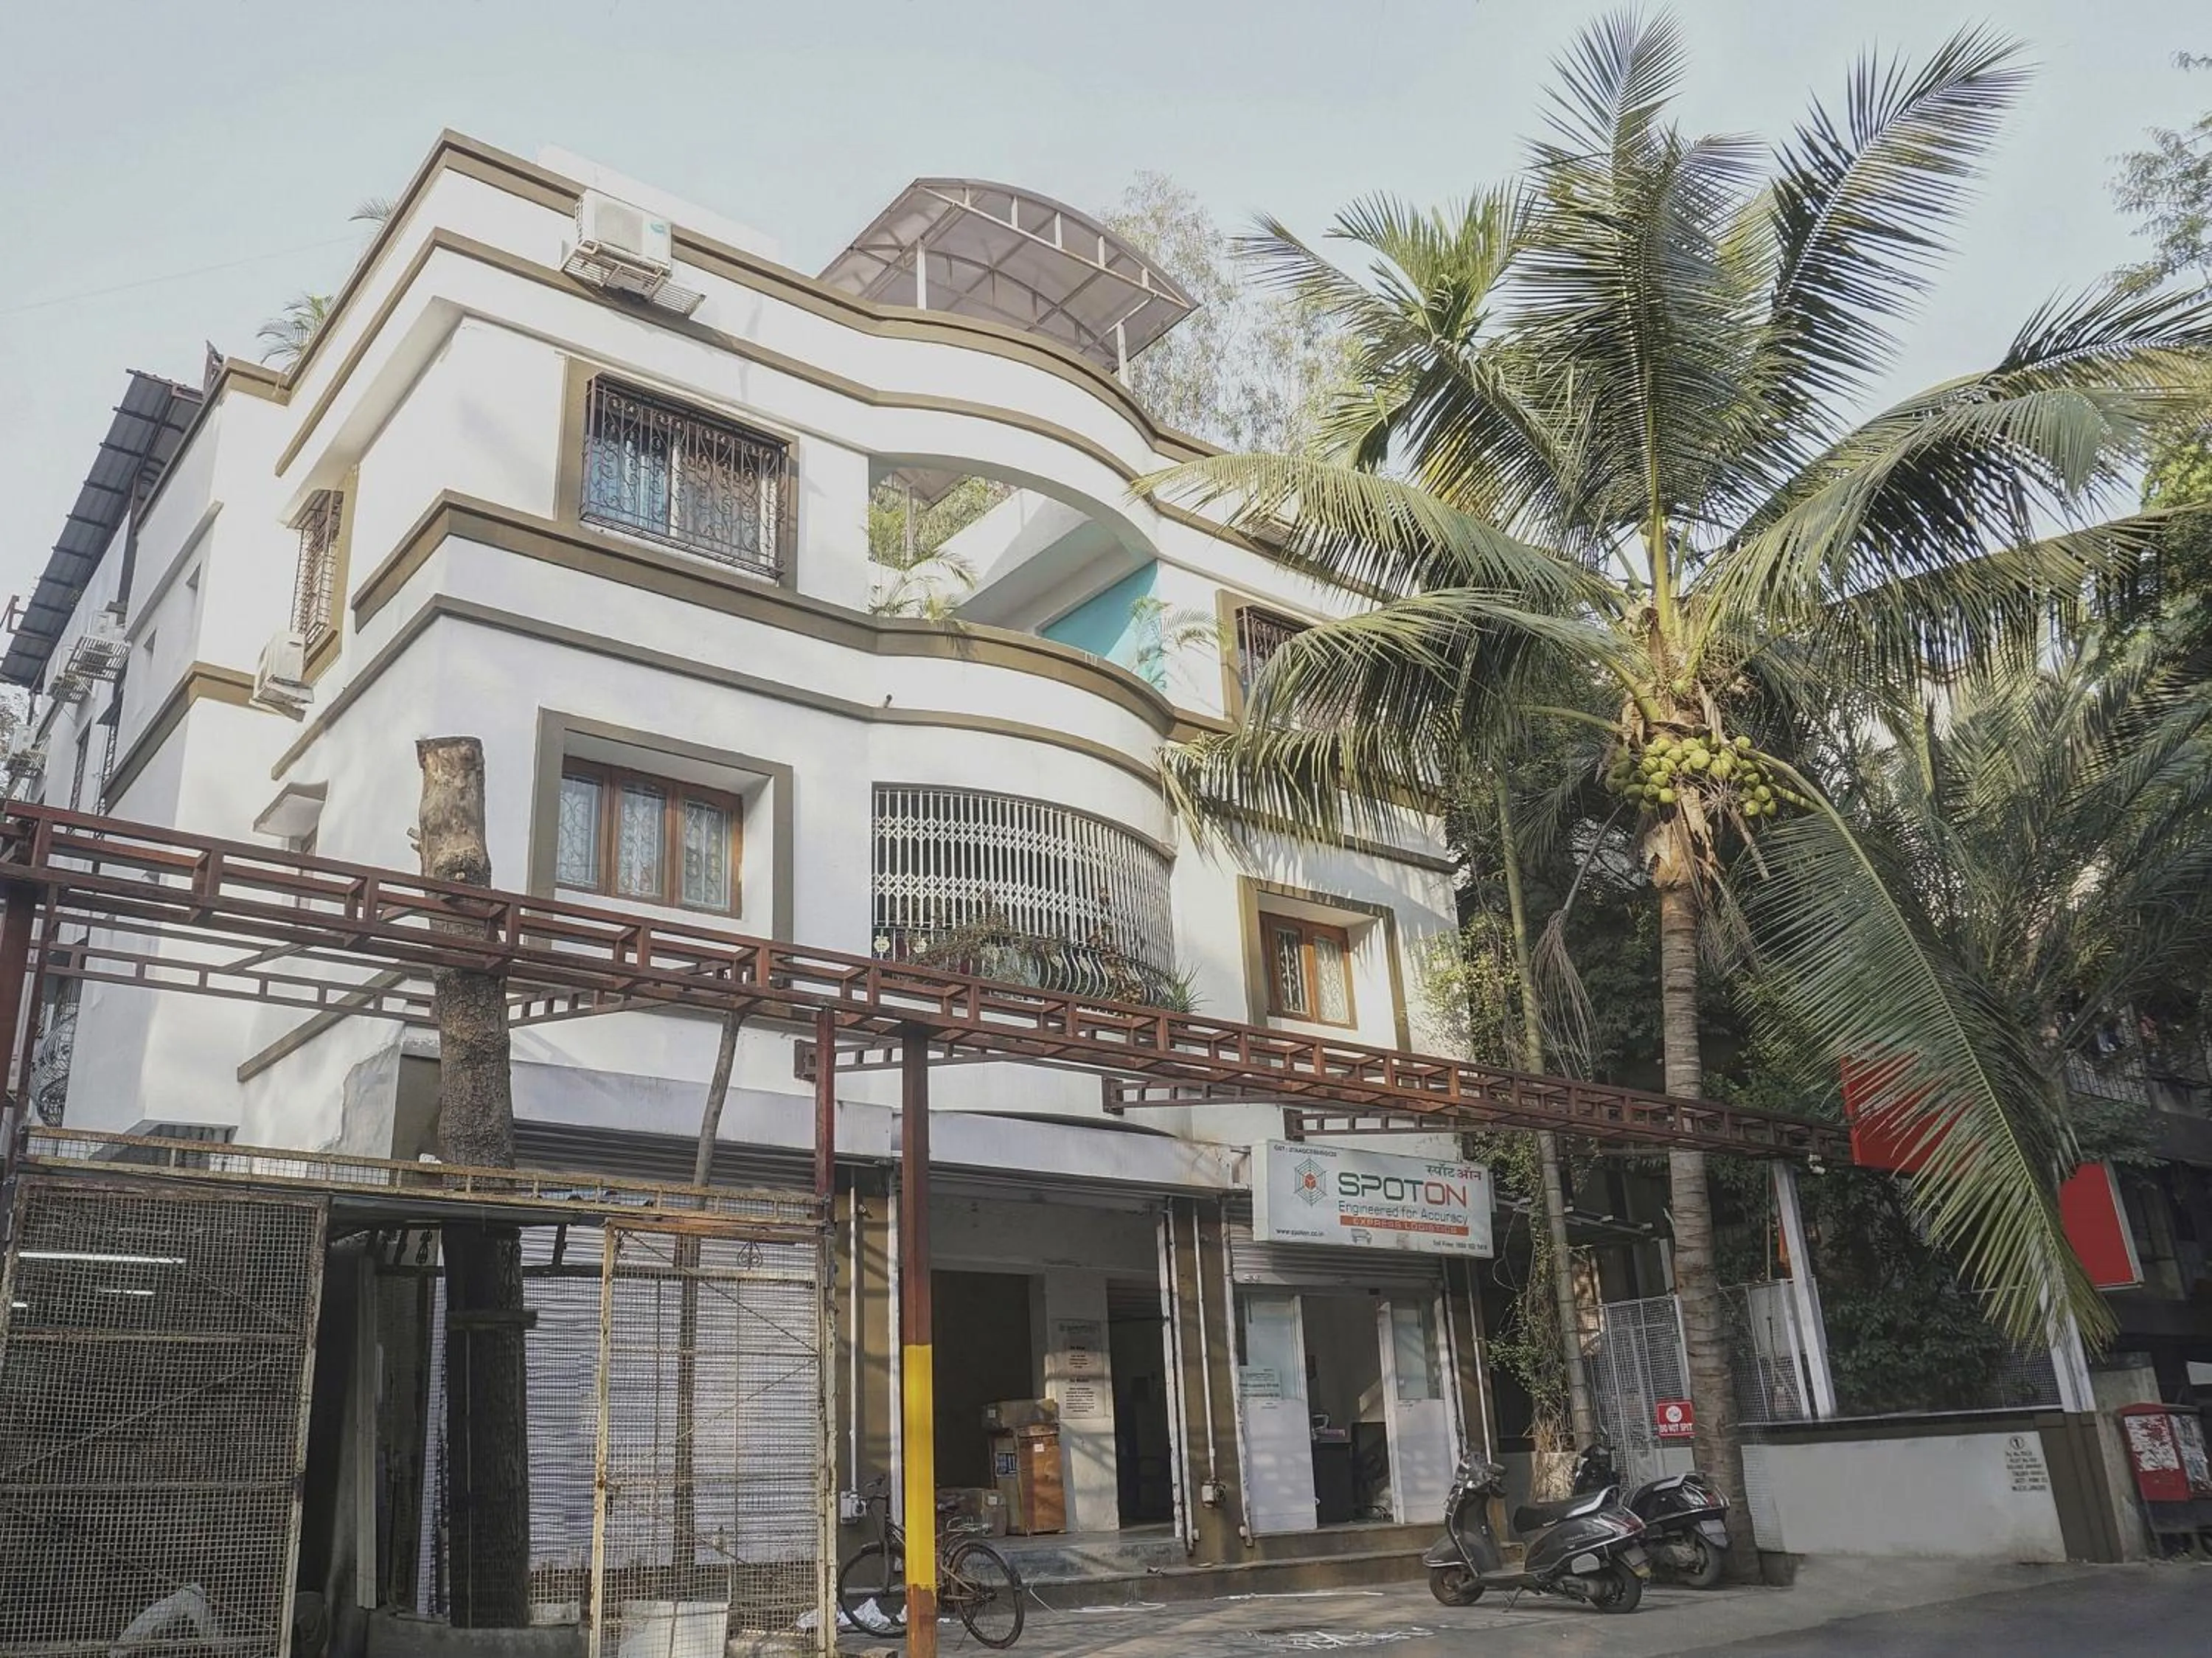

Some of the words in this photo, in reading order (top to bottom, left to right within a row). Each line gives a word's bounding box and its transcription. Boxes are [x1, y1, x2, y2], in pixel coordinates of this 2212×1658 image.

[1338, 1172, 1467, 1207] SPOTON
[1338, 1201, 1399, 1217] Engineered
[1401, 1206, 1419, 1218] for
[1421, 1208, 1468, 1226] Accuracy
